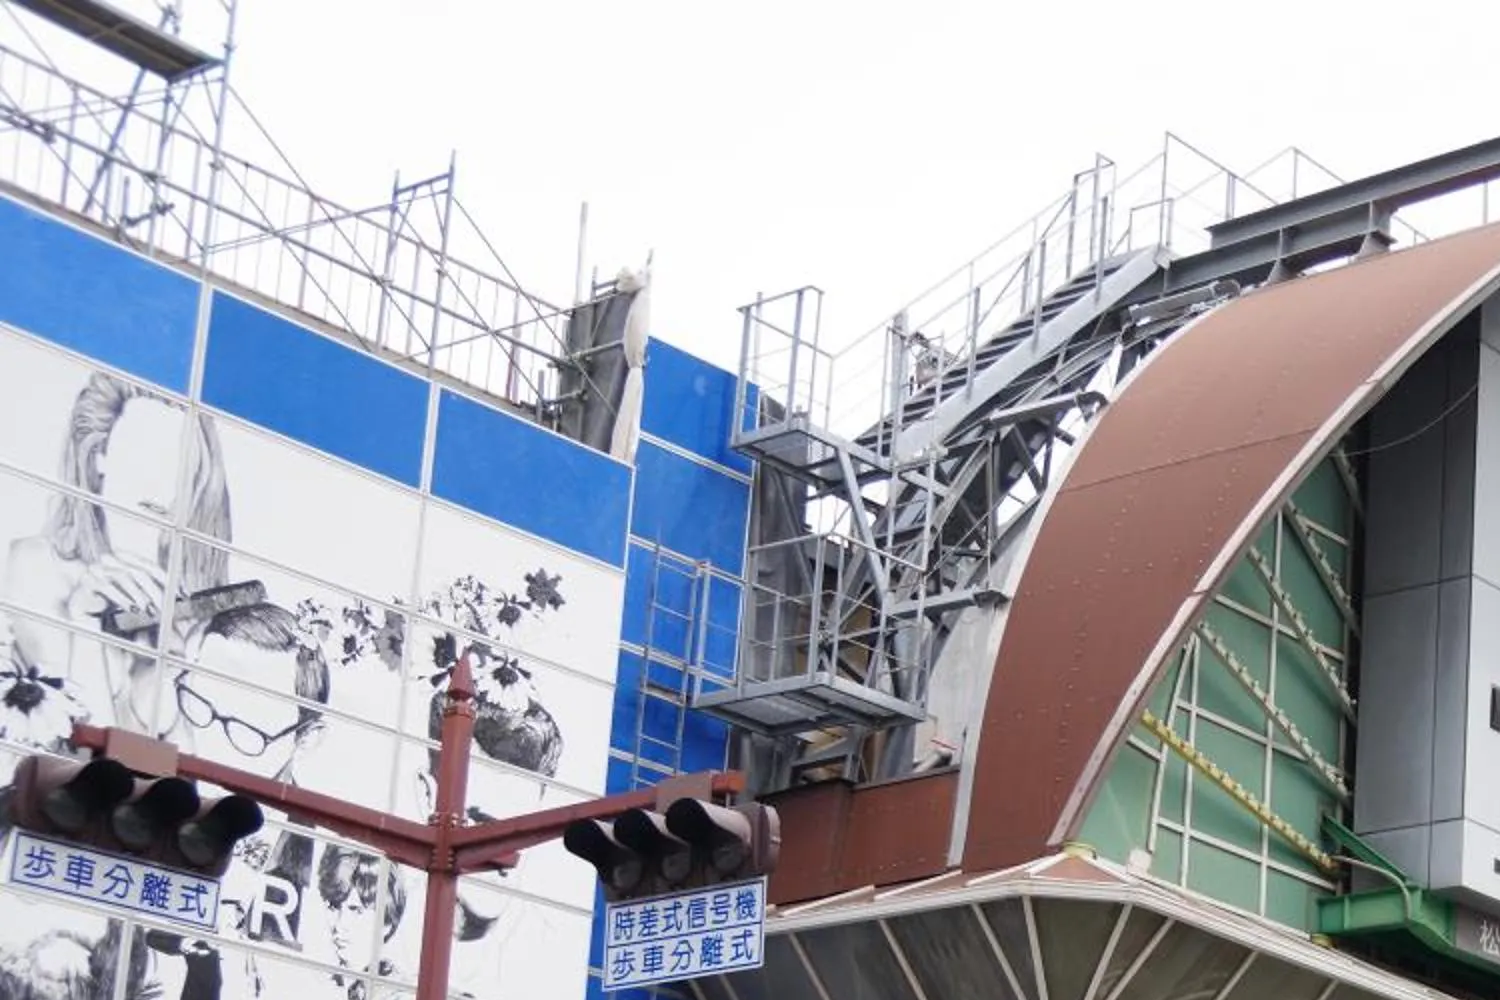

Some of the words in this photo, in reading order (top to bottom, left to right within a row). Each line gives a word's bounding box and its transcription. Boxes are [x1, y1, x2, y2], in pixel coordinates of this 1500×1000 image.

[23, 845, 209, 918] 歩車分離式
[614, 888, 757, 941] 時差式信号機
[611, 929, 753, 981] 歩車分離式
